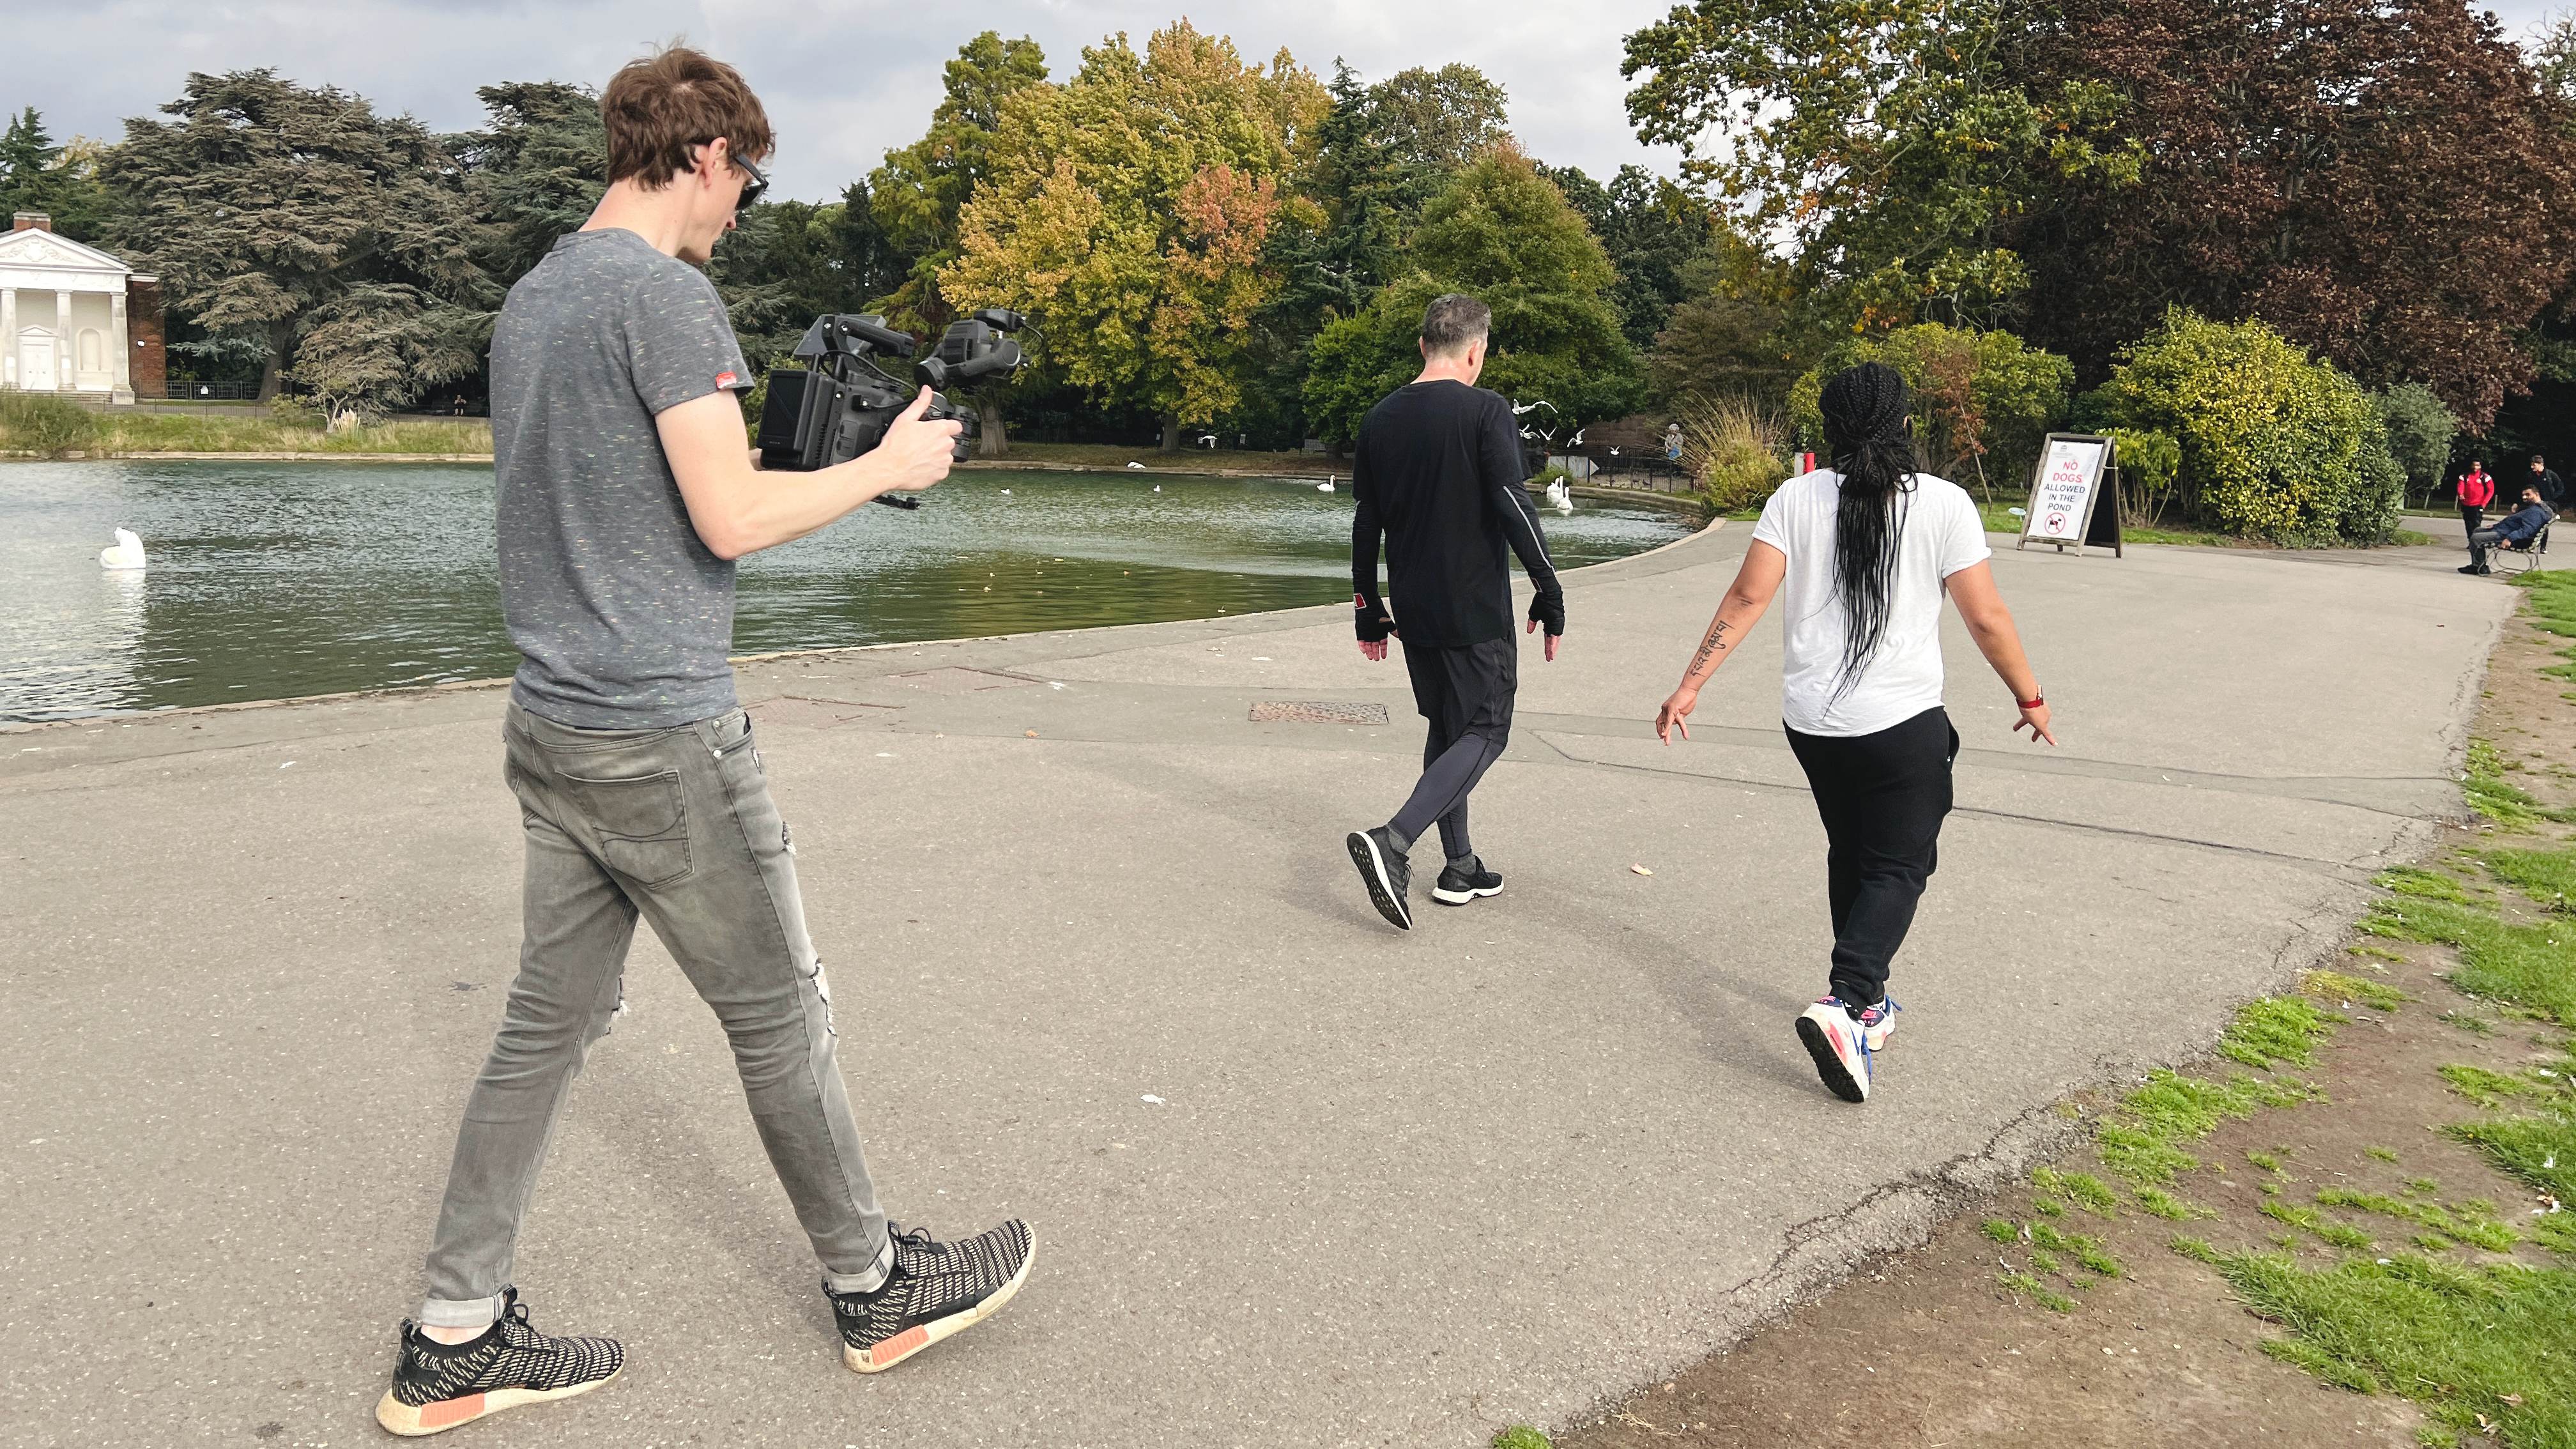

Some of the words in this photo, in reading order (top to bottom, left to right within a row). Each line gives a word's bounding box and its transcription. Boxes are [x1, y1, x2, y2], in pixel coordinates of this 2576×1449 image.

[2063, 461, 2078, 470] NO
[2053, 473, 2083, 483] DOGS
[2044, 484, 2085, 493] ALLOWED
[2060, 494, 2076, 502] THE
[2048, 503, 2071, 511] POND
